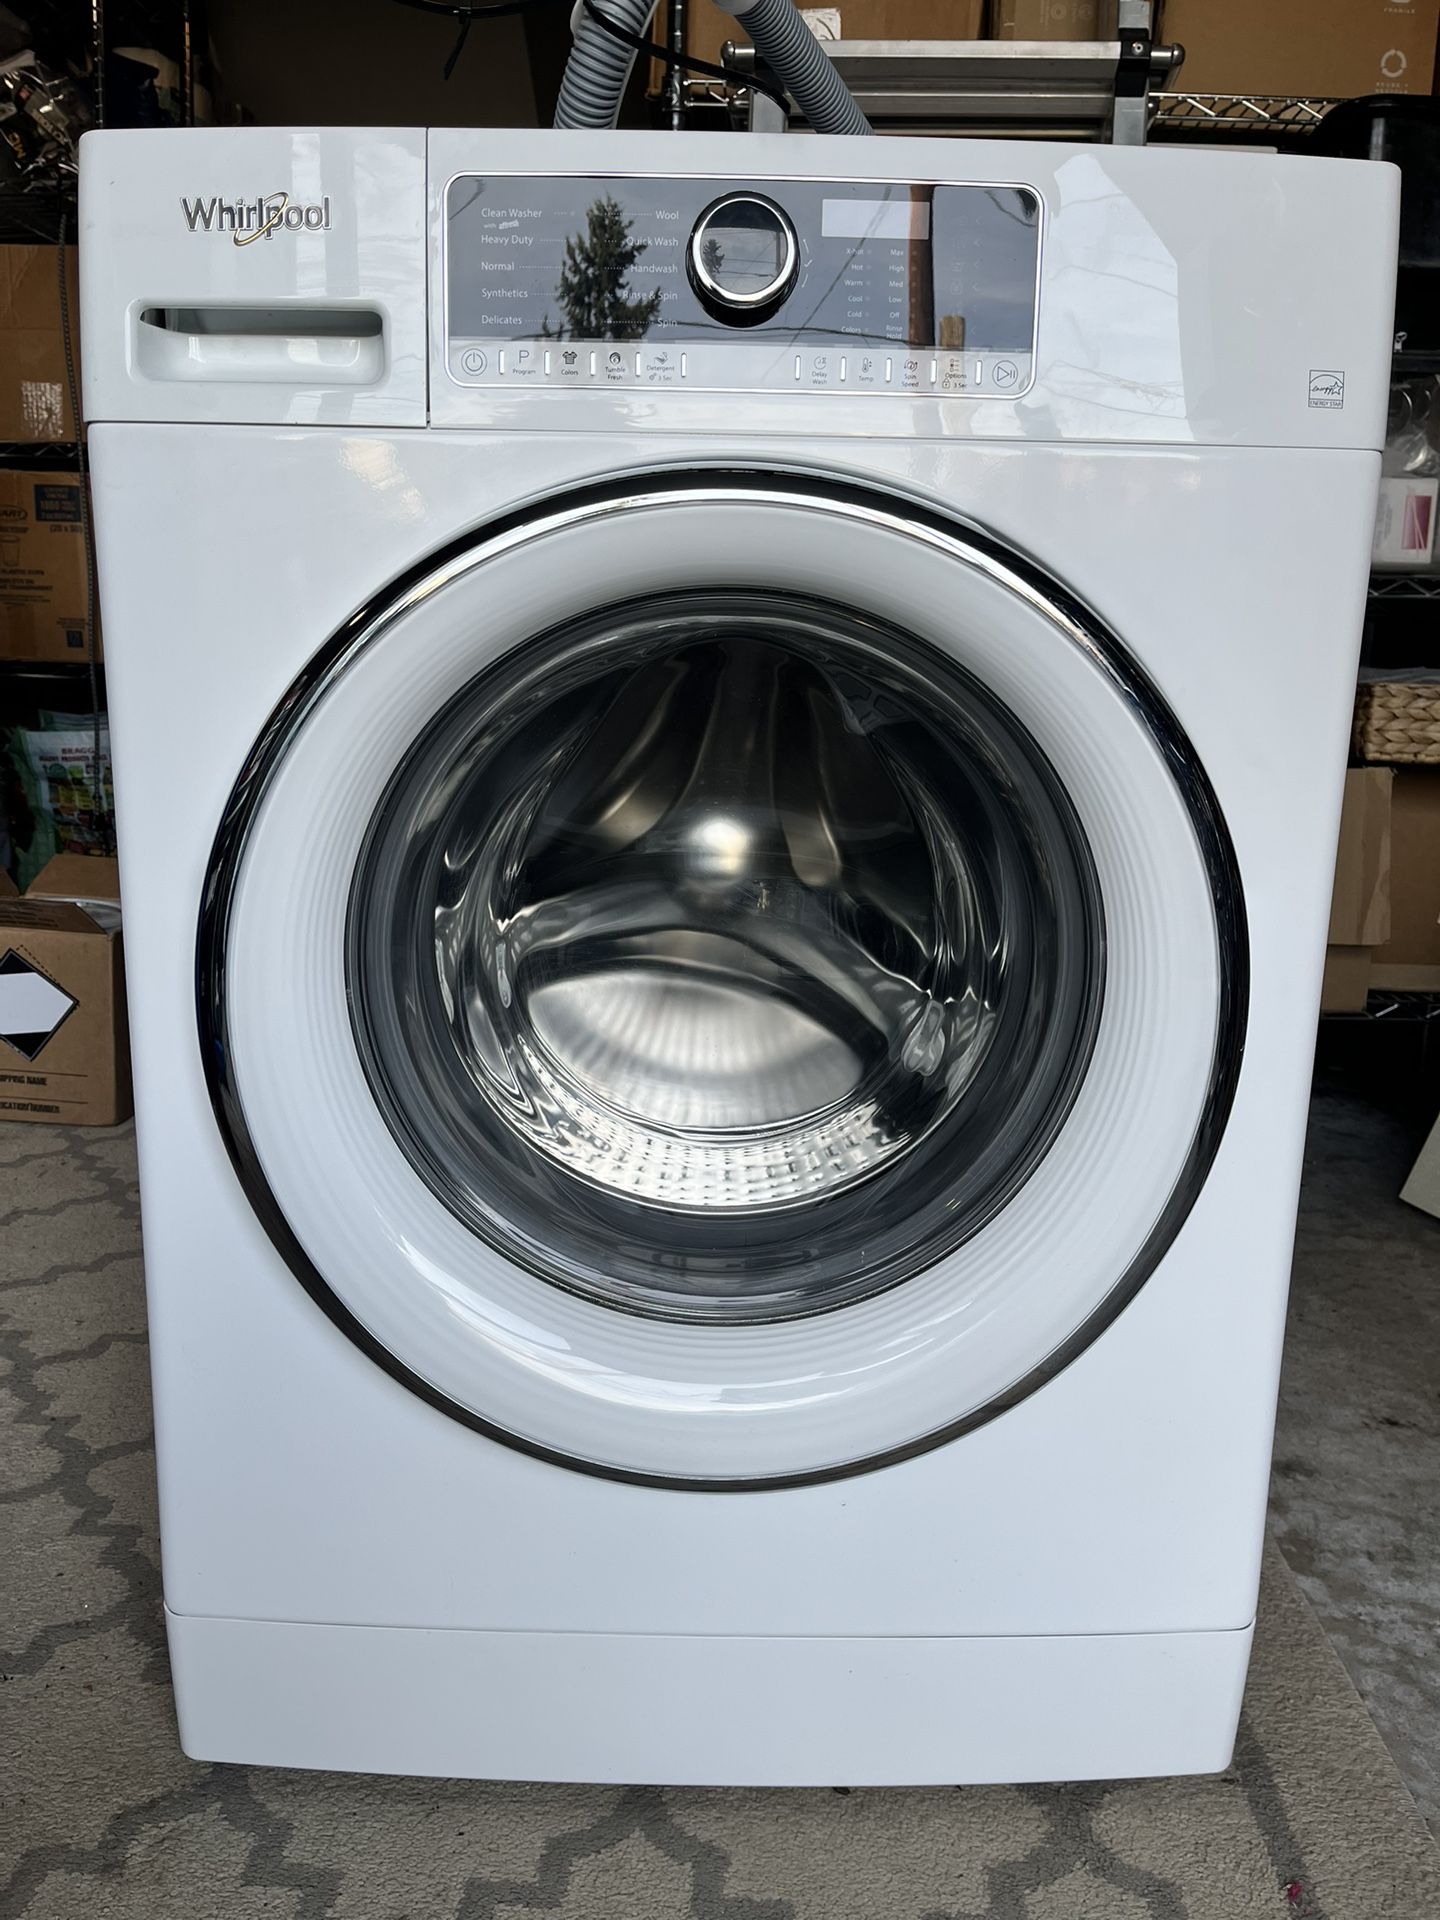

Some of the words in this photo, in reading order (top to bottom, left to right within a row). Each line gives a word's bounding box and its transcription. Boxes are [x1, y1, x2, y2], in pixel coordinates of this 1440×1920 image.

[181, 194, 331, 241] Whirlpool
[481, 208, 507, 218] Clean
[508, 208, 542, 218] Washer
[655, 210, 679, 220] Wool
[481, 235, 509, 246] Heavy
[511, 235, 534, 246] Duty
[626, 236, 653, 246] Quick
[654, 237, 679, 246] Wash
[481, 262, 515, 271] Normal
[630, 264, 678, 273] Handwash
[889, 265, 904, 273] High
[481, 288, 528, 299] Synthetics
[622, 290, 647, 300] Rinse
[648, 290, 656, 300] &
[658, 291, 678, 301] Spin
[481, 315, 522, 324] Delicates
[889, 311, 901, 319] Off
[657, 318, 678, 329] Spin
[886, 332, 902, 340] Hold
[512, 368, 536, 376] Program
[561, 368, 579, 376] Colors
[605, 366, 626, 374] Tumble
[859, 375, 874, 383] Temp
